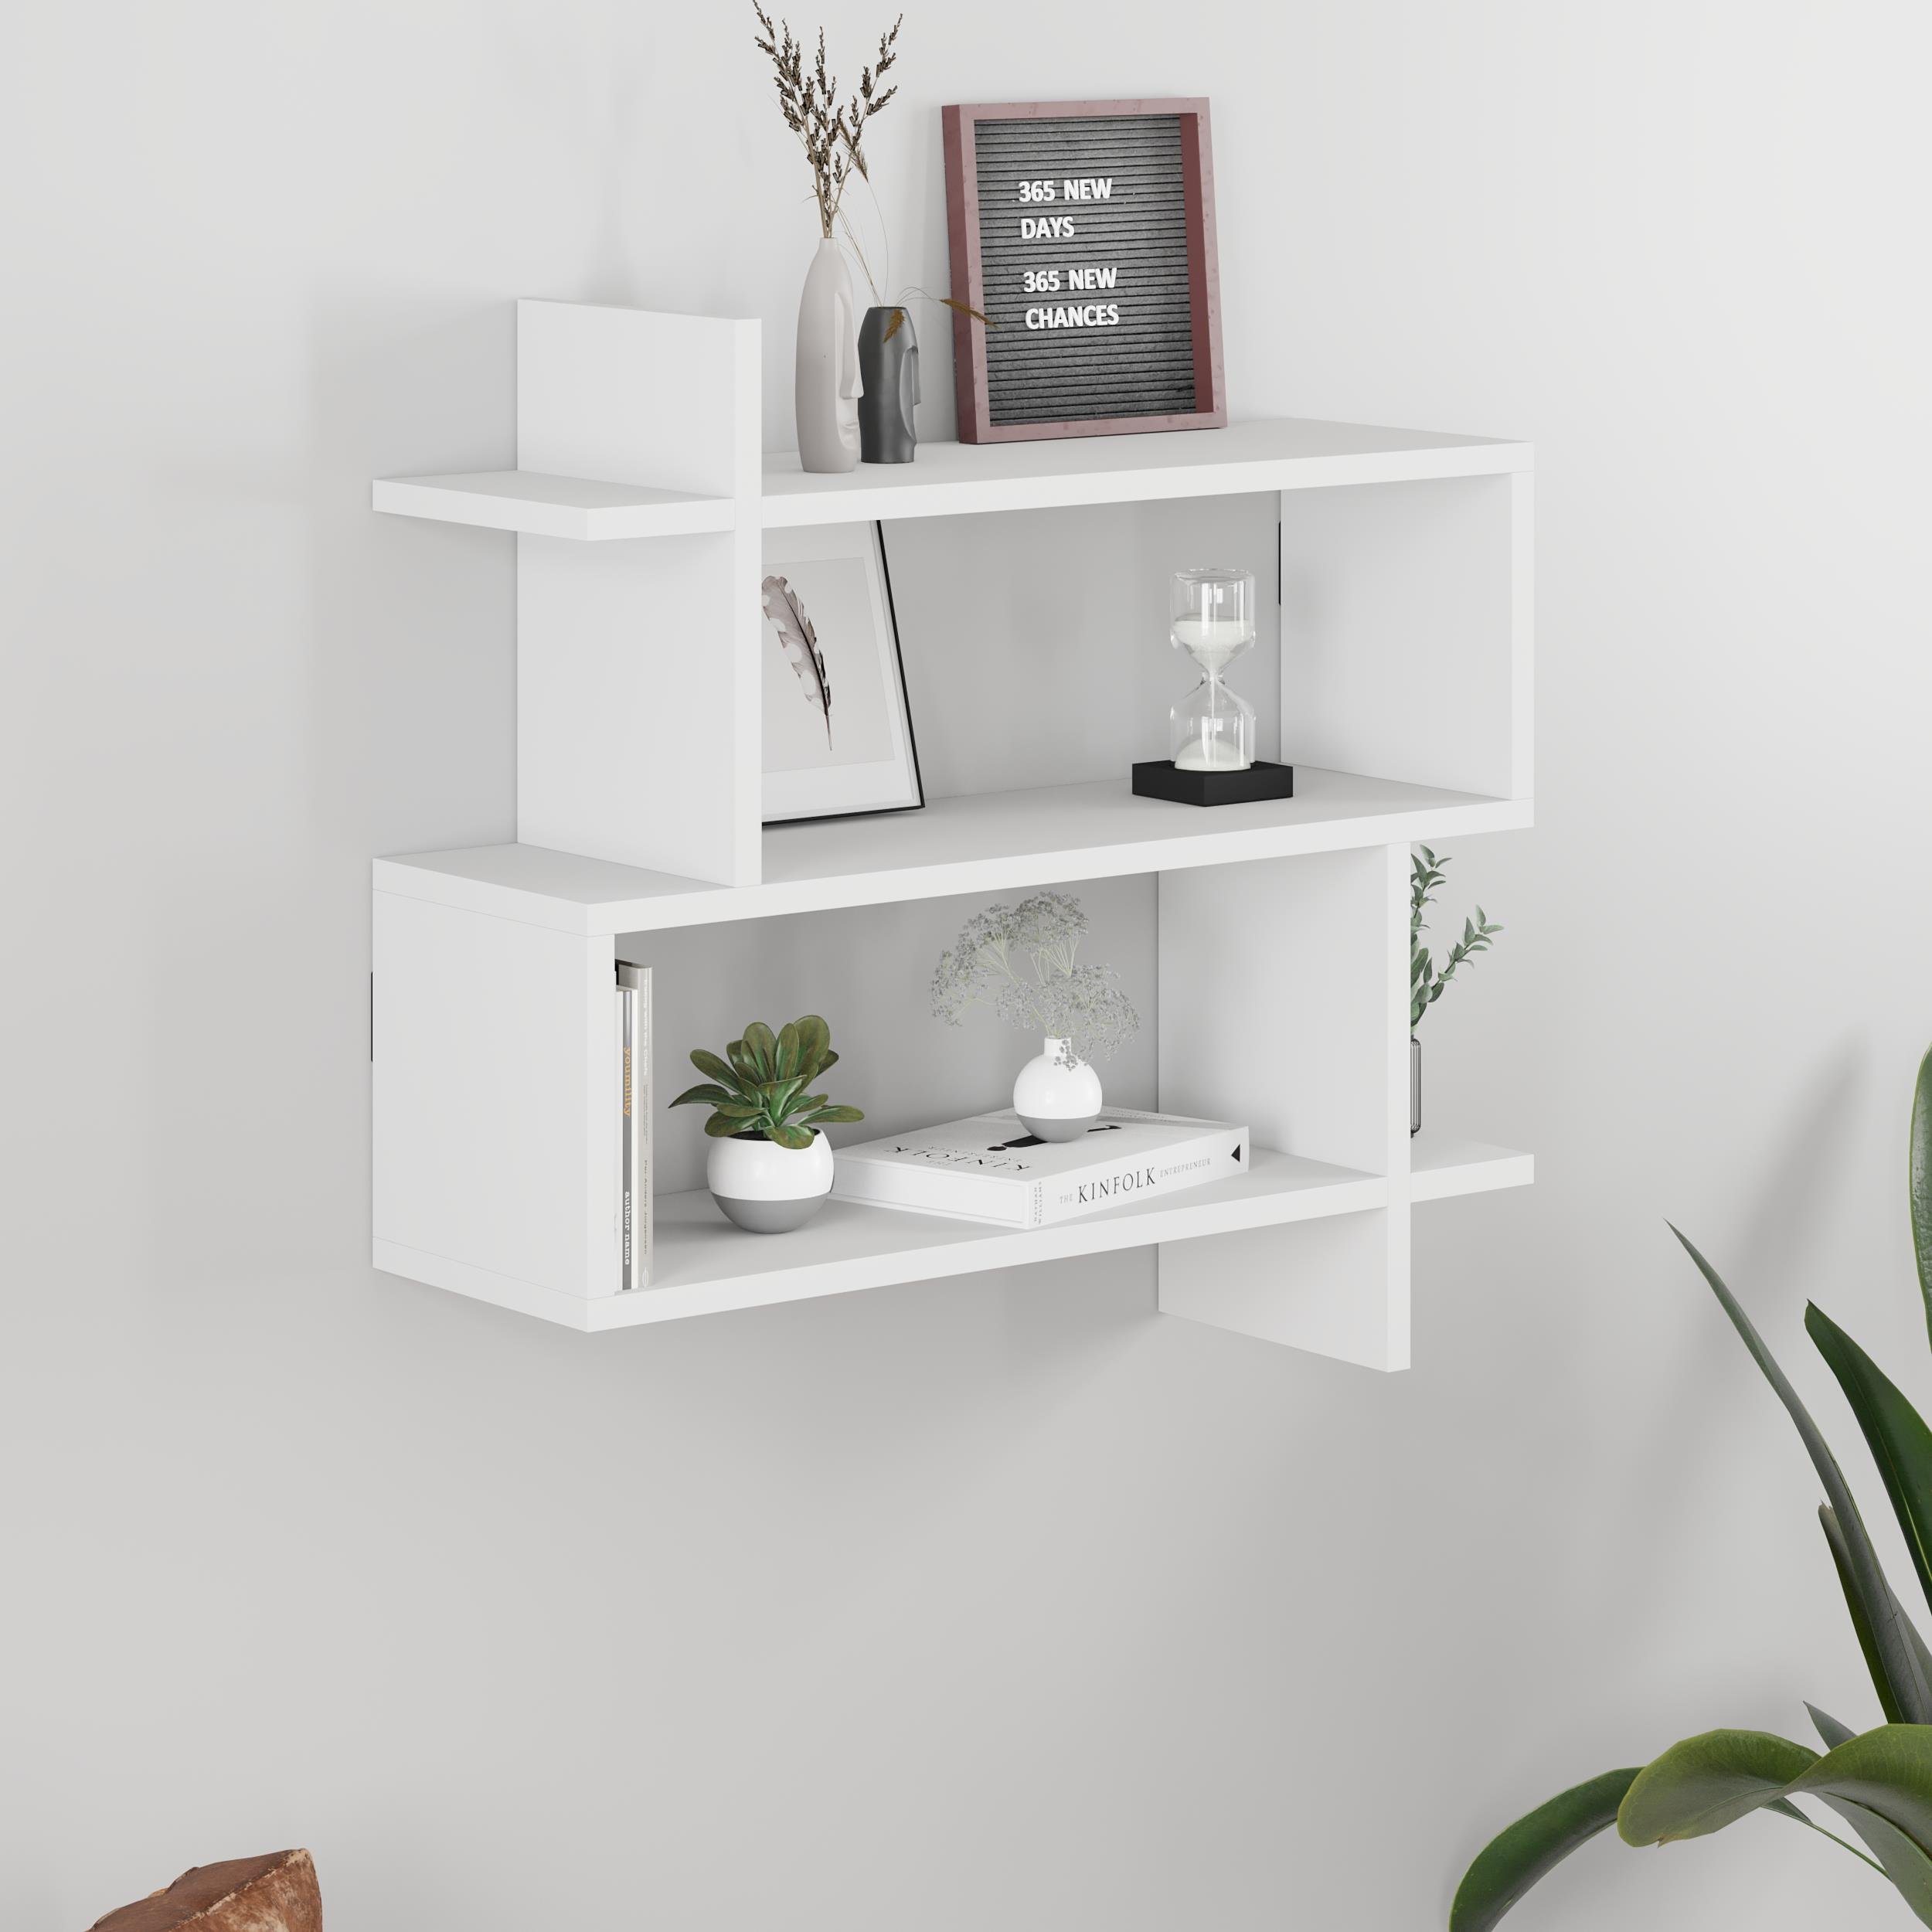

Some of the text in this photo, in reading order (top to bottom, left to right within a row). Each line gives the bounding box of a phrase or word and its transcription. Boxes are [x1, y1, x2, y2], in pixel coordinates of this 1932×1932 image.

[1018, 178, 1113, 202] 365 NEW
[1020, 216, 1075, 240] DAYS
[1023, 267, 1117, 292] 365 NEW
[1025, 304, 1120, 329] CHANCES
[1058, 1158, 1211, 1205] THE KINFOLK ENTREPRENEUR
